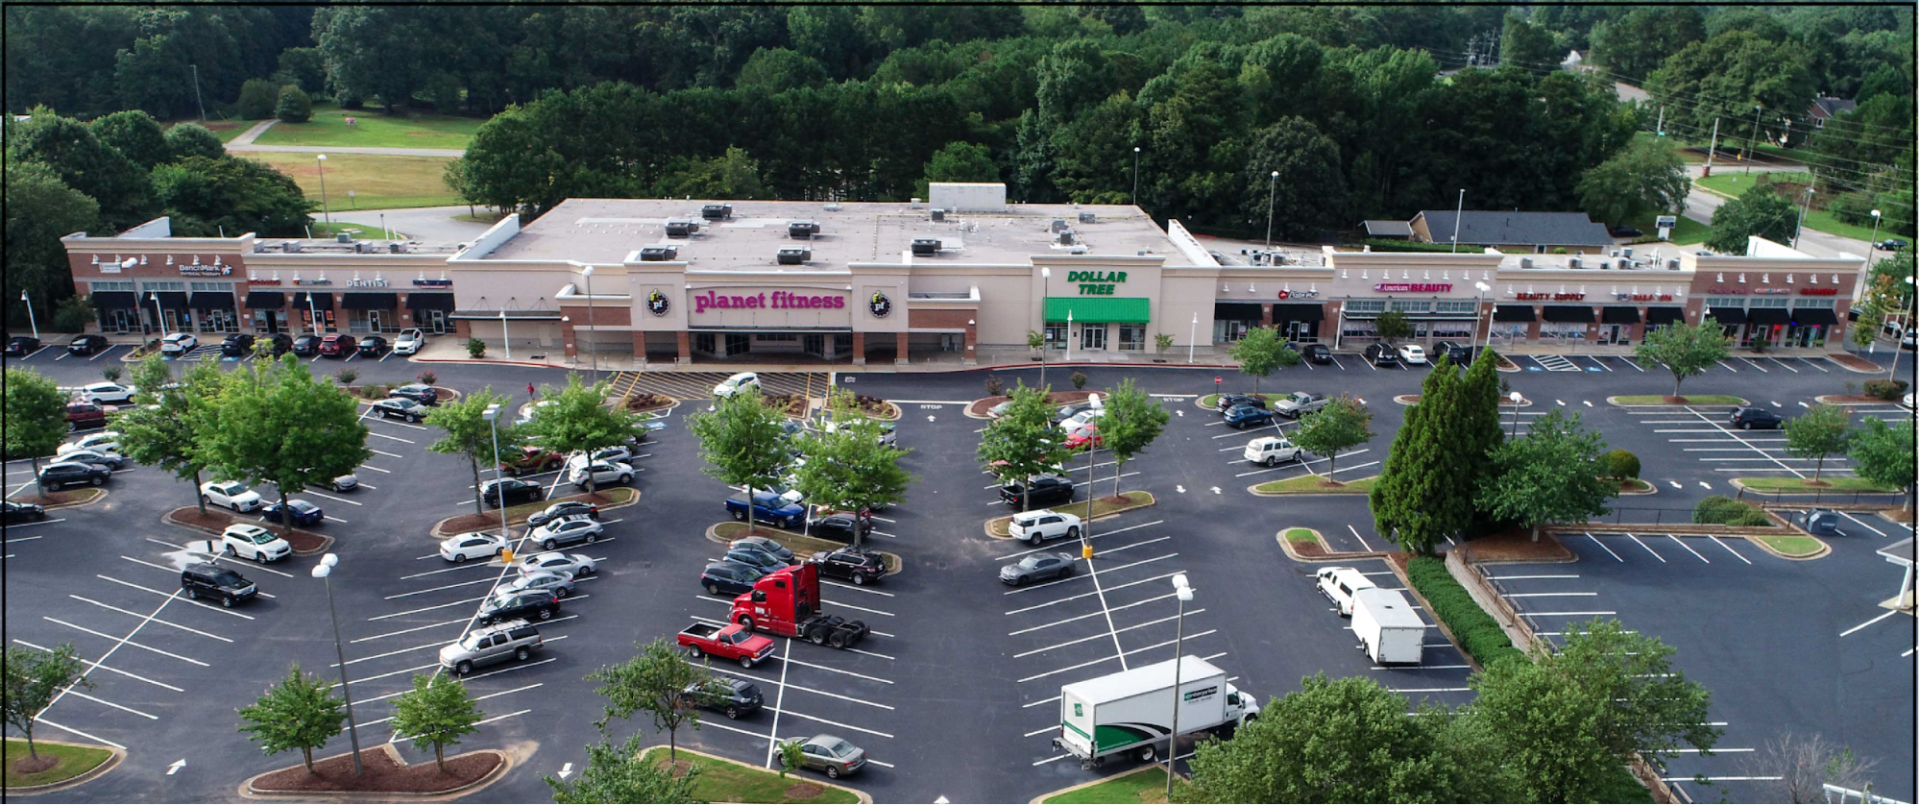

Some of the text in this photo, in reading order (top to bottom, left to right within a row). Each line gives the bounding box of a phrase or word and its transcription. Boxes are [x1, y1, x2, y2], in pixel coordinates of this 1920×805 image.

[1067, 271, 1128, 282] DOLLAR
[1078, 284, 1116, 295] TREE
[1410, 283, 1453, 292] BEAUTY
[695, 290, 845, 313] planet fitness
[1517, 293, 1585, 301] BEAUTY SUPPLY
